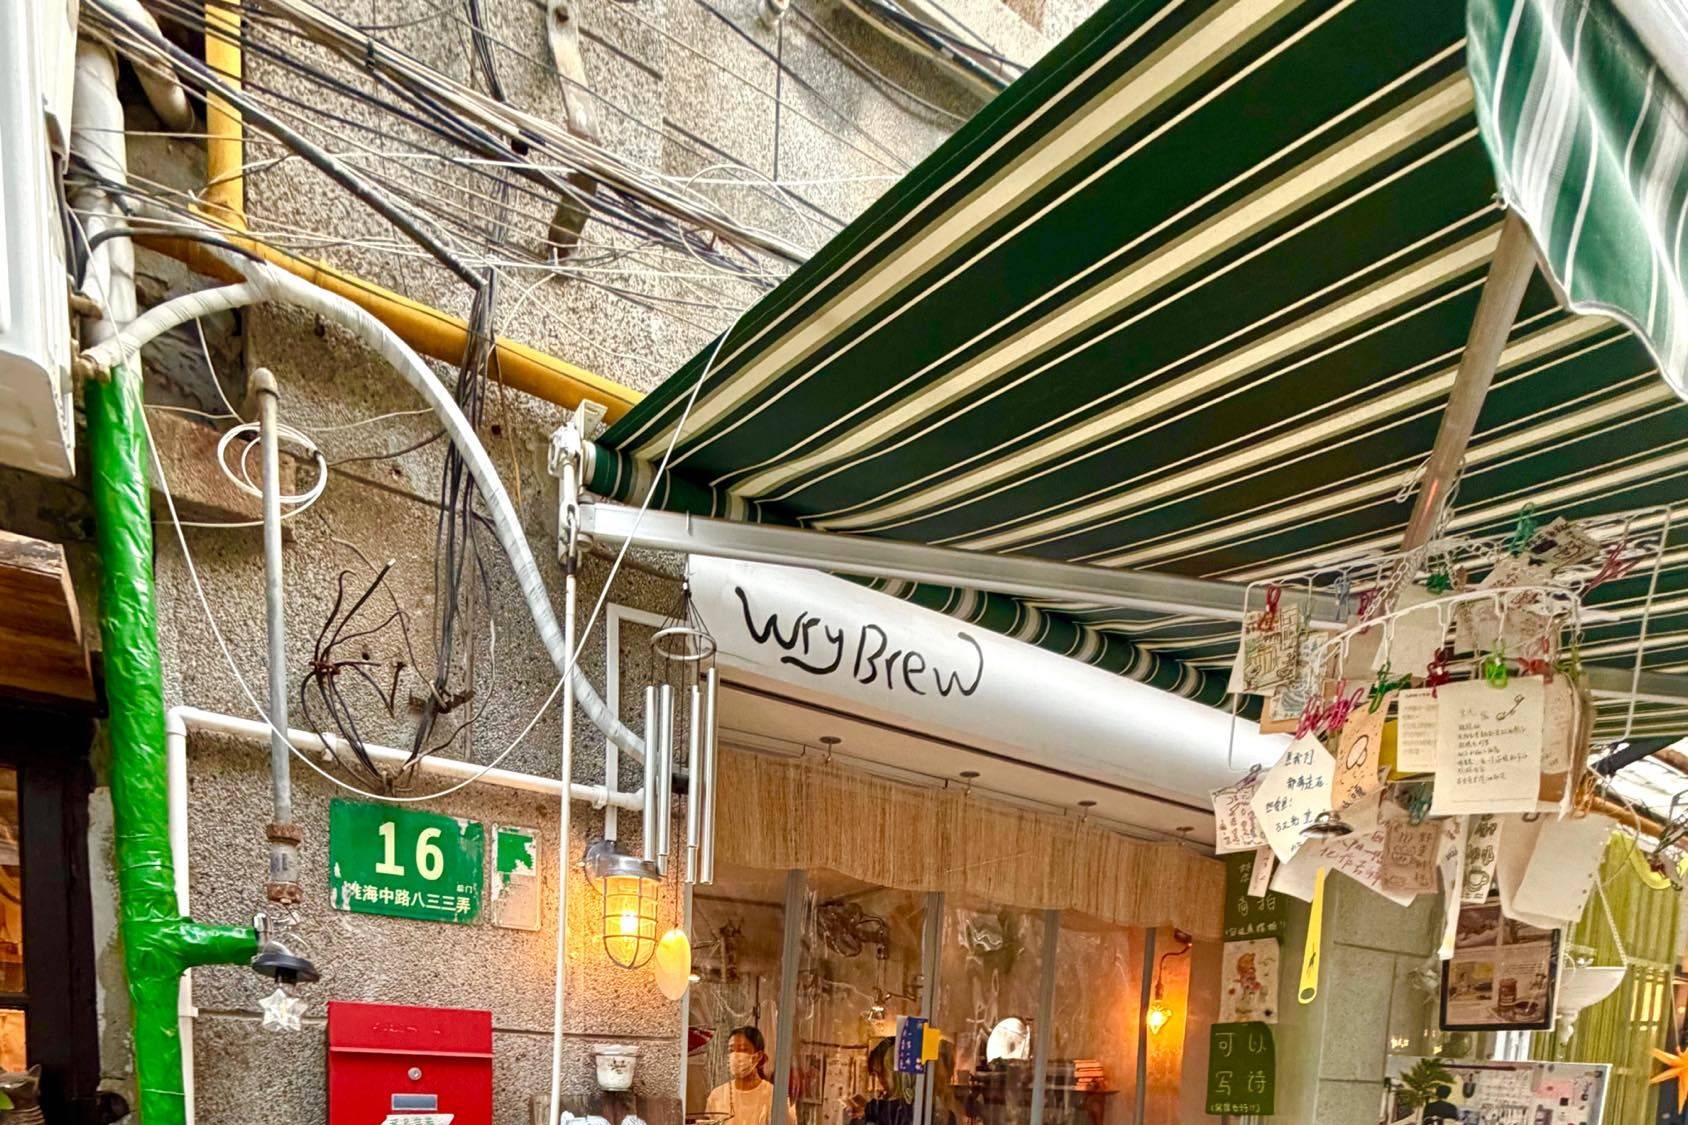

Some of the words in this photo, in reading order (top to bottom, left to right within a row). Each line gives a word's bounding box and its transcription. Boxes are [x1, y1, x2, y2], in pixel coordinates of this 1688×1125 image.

[375, 821, 444, 881] 16
[1215, 1032, 1267, 1057] 可以
[1215, 1070, 1266, 1096] 写诗
